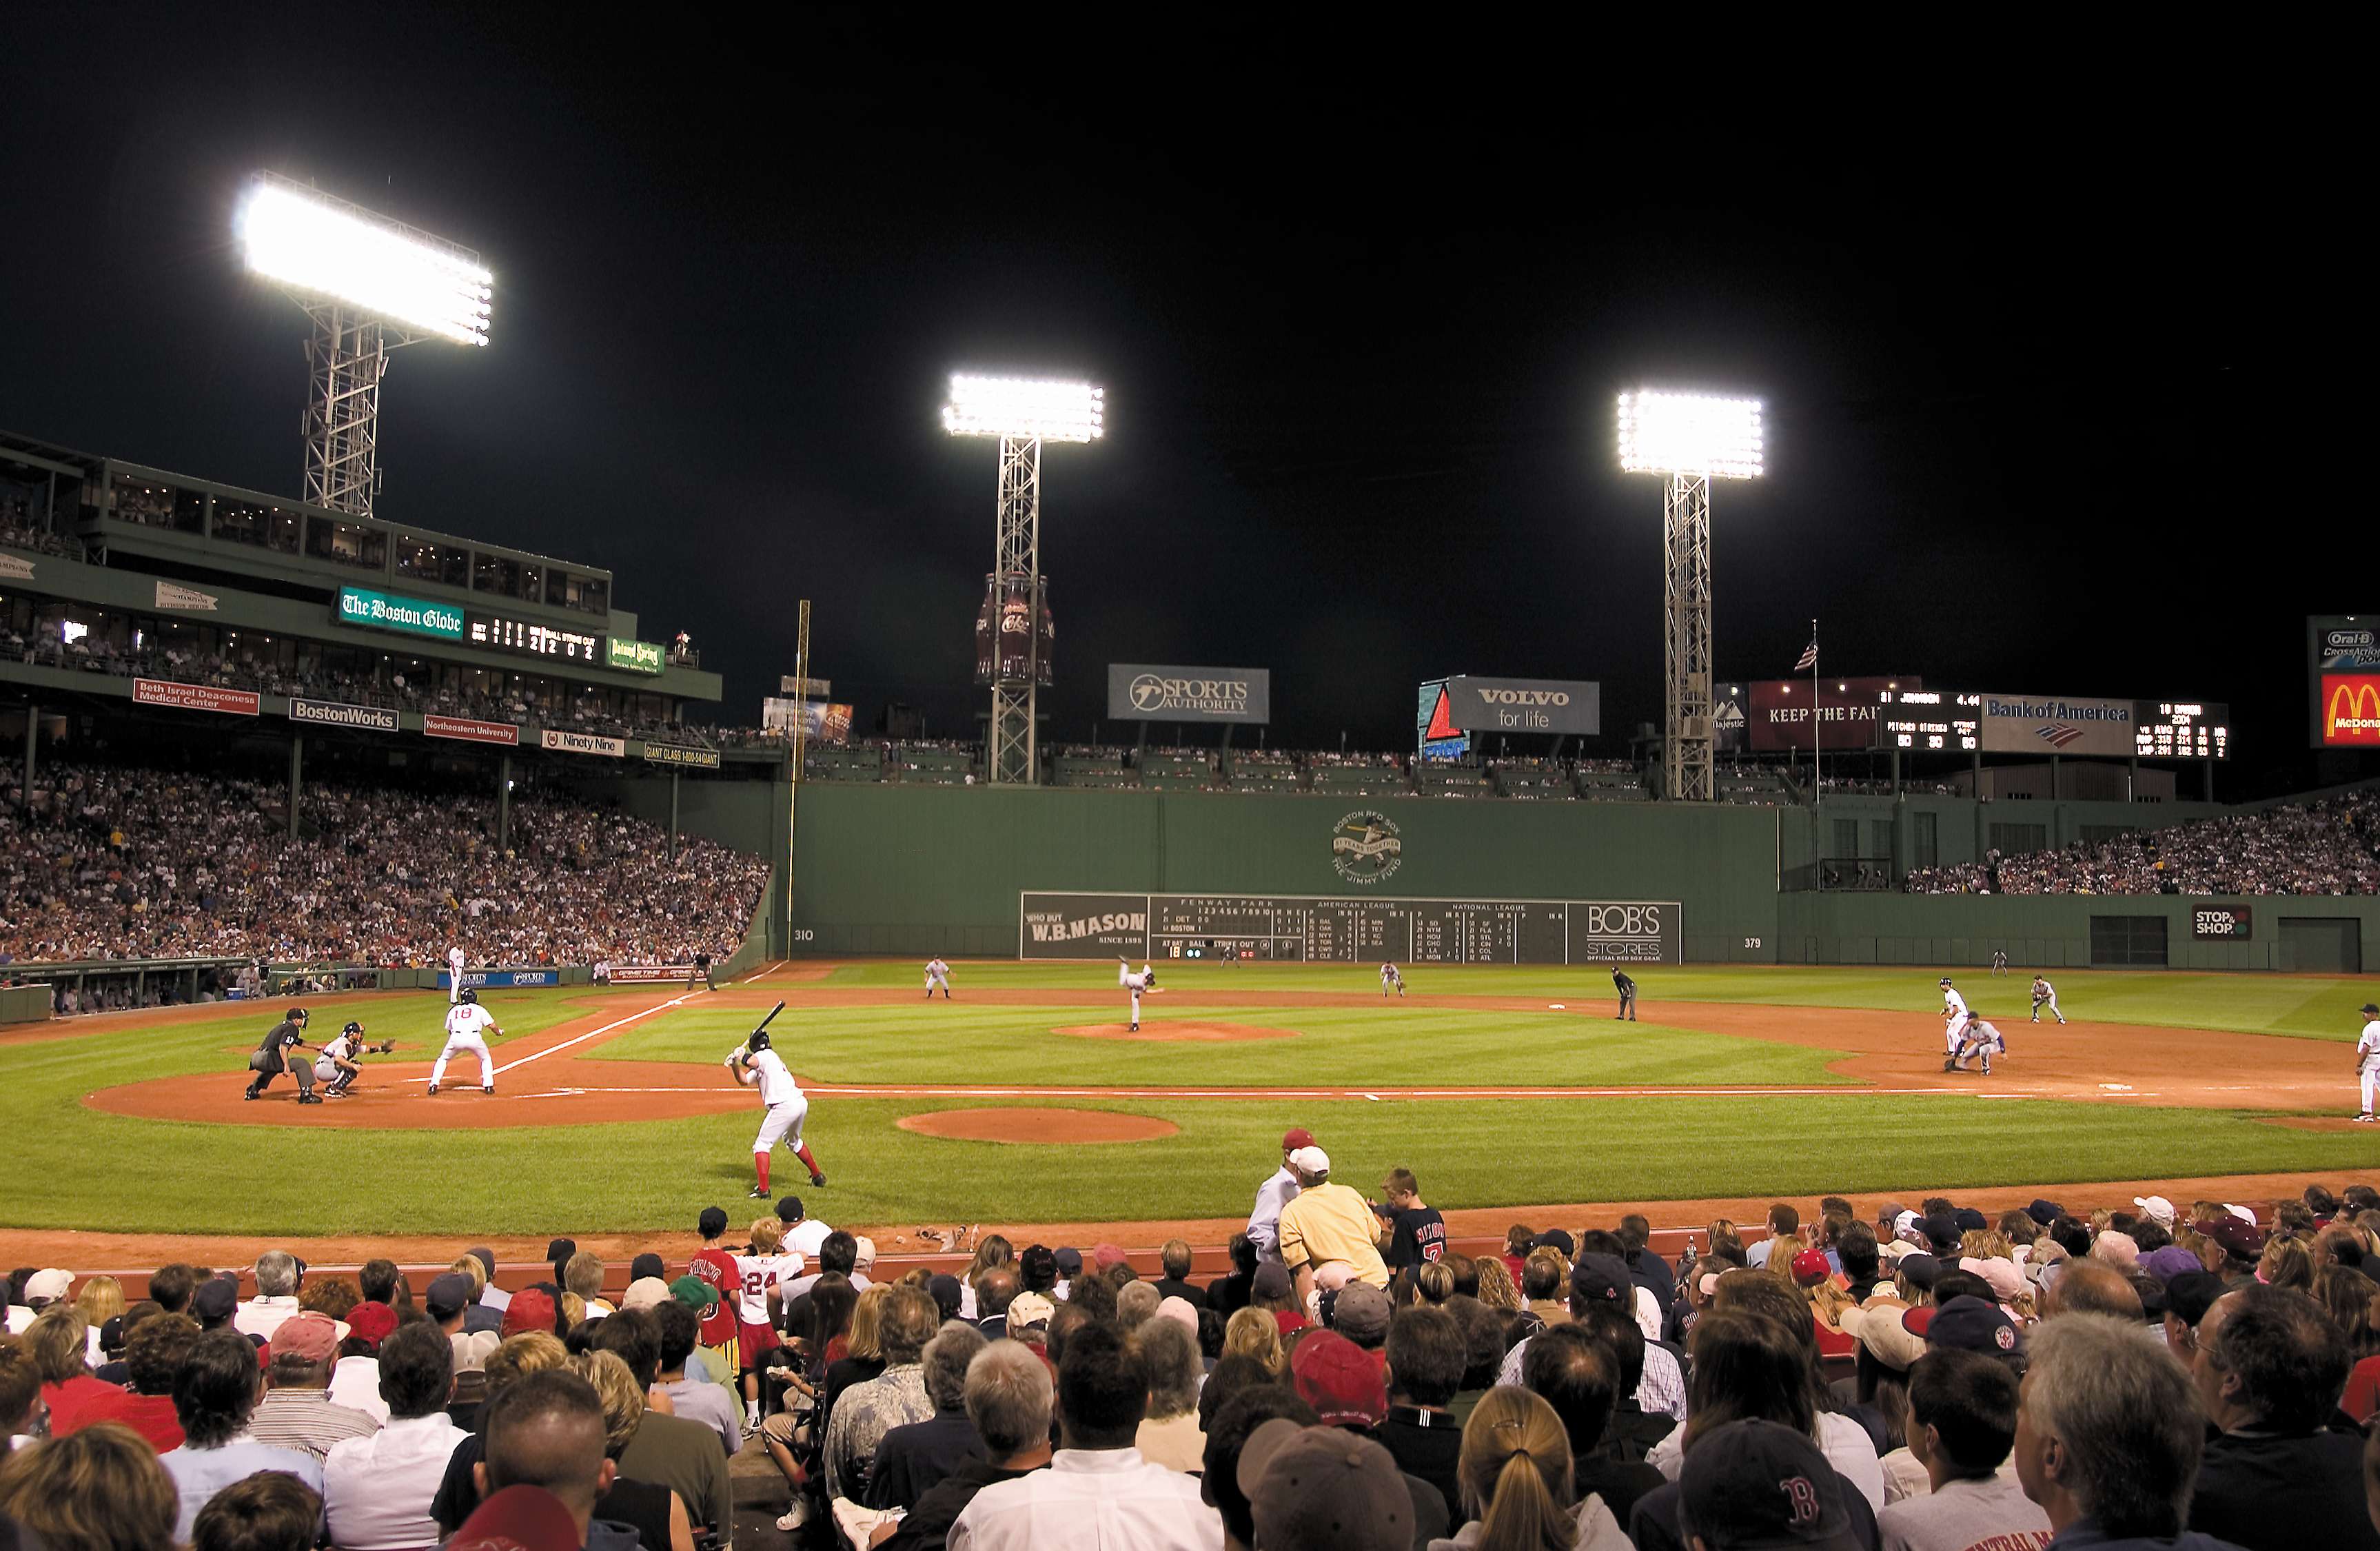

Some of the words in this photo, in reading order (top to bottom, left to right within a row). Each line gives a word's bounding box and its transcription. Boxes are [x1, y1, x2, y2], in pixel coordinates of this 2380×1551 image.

[343, 594, 369, 616] The
[372, 599, 421, 626] Boston
[423, 609, 460, 632] Globe
[529, 636, 538, 651] 2
[548, 639, 557, 653] 2
[567, 642, 576, 657] 0
[584, 645, 593, 660] 2
[582, 636, 596, 647] OUT
[140, 682, 164, 693] Beth
[167, 686, 195, 696] Israel
[199, 690, 254, 704] Deaconess
[1163, 679, 1248, 700] SPORTS
[1477, 688, 1569, 707] VOLVO
[139, 691, 180, 704] Medical
[183, 697, 218, 709] Center
[1163, 698, 1245, 710] AUTHORITY
[1956, 693, 1980, 707] 4.44
[296, 702, 394, 728] BostonWorks
[1499, 709, 1520, 727] for
[1525, 710, 1549, 728] life
[1769, 709, 1809, 722] KEEP
[1813, 707, 1845, 721] THE
[1985, 700, 2033, 718] Bank
[2034, 701, 2054, 718] of
[2055, 702, 2129, 722] America
[427, 720, 476, 734] Northeastern
[478, 726, 513, 740] University
[564, 733, 593, 750] Ninety
[595, 738, 616, 751] Nine
[646, 746, 662, 758] GIANT
[663, 748, 681, 761] GLASS
[2217, 747, 2224, 758] 2
[1333, 811, 1364, 833] BOSTON
[1366, 810, 1383, 821] RED
[1384, 818, 1401, 835] SOX
[1347, 875, 1377, 885] JIMMY
[1379, 858, 1401, 880] FUND
[1181, 898, 1231, 906] FENWAY
[1026, 913, 1046, 922] WHO
[1588, 905, 1660, 934] BOB'S
[2196, 911, 2230, 922] STOP
[795, 930, 813, 940] 310
[1745, 937, 1761, 949] 379
[1587, 942, 1659, 955] STORES
[522, 972, 545, 981] SPORTS
[455, 1008, 472, 1020] 18
[1416, 1222, 1445, 1245] NIXON
[1423, 1241, 1443, 1264] 7
[746, 1271, 777, 1296] 24
[1780, 1477, 1819, 1523] B
